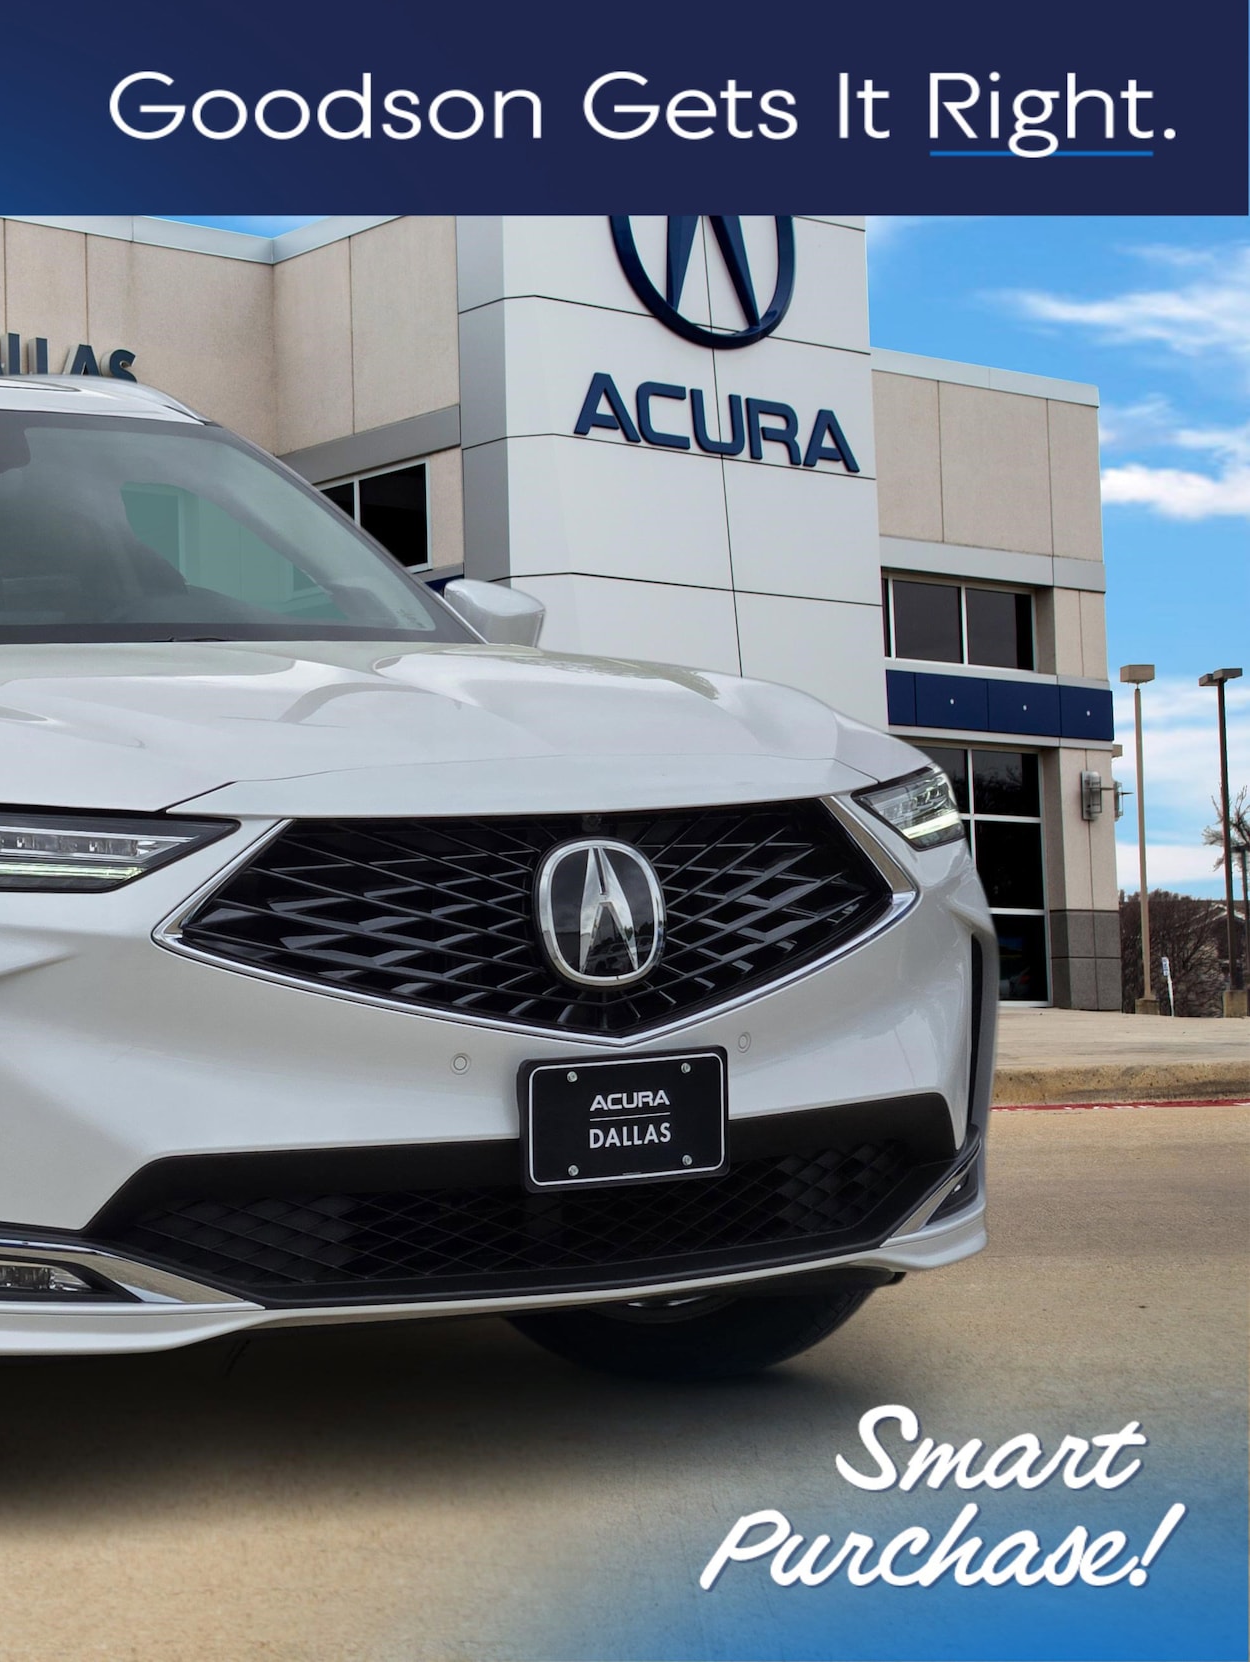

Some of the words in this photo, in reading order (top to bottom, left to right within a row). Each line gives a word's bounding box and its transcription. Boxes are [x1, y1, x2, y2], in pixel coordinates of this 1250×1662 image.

[573, 371, 861, 473] ACURA
[589, 1089, 671, 1112] ACURA
[589, 1122, 672, 1149] DALLAS
